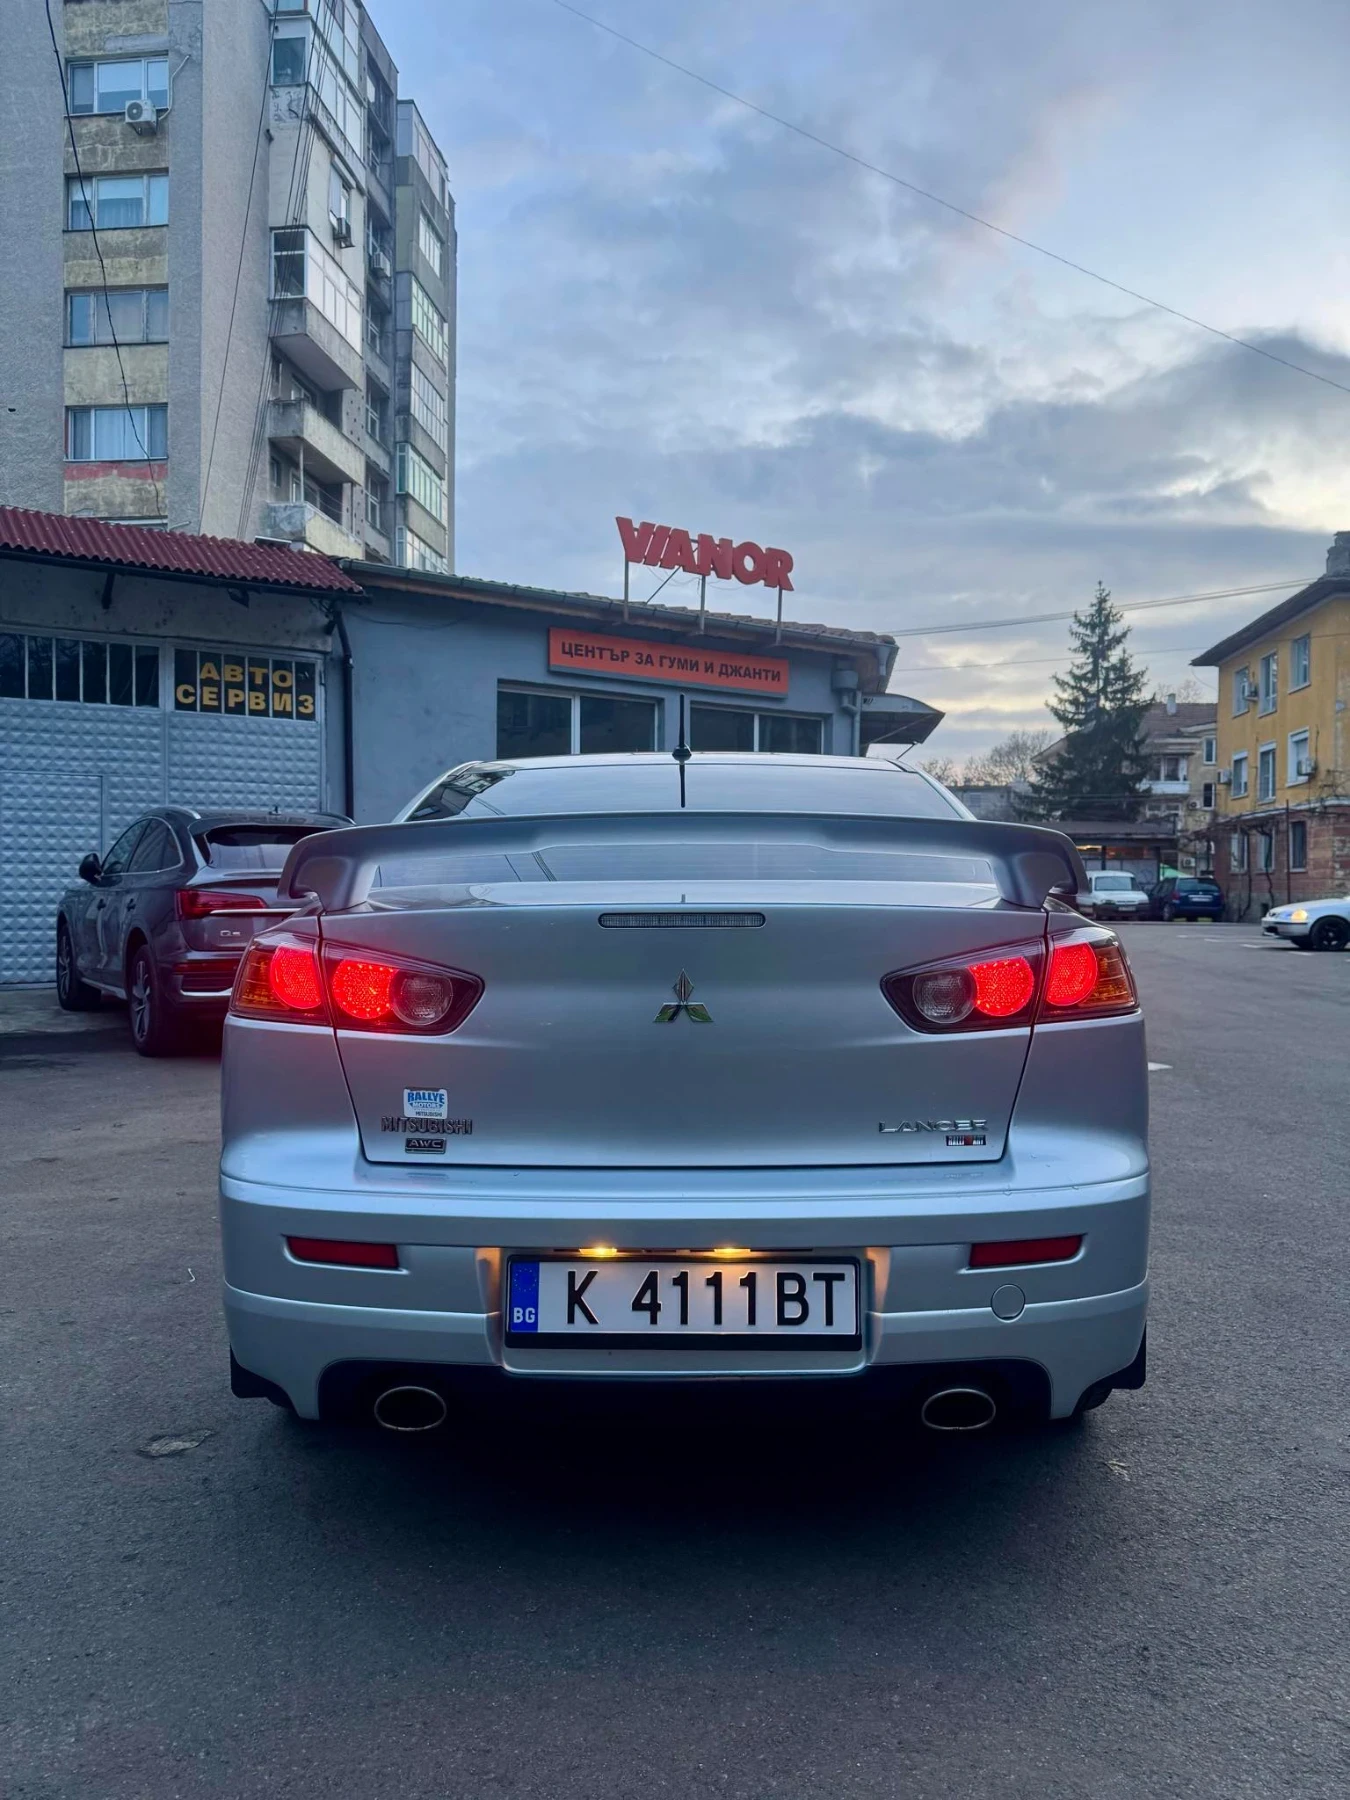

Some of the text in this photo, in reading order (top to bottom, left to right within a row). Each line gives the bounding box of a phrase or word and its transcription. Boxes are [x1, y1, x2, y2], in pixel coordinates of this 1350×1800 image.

[615, 516, 794, 591] VIANOR
[561, 641, 781, 682] ЦЕНТЪР ЗА ГУМИ И ДЖАНТИ
[199, 662, 293, 688] АВТО
[176, 684, 314, 714] СЕРВИЗ
[407, 1091, 445, 1105] RALLYE
[381, 1116, 473, 1135] MITSUBISHI
[879, 1119, 989, 1132] LANCER
[409, 1139, 441, 1148] AWC
[567, 1270, 599, 1325] K
[513, 1307, 536, 1323] BG
